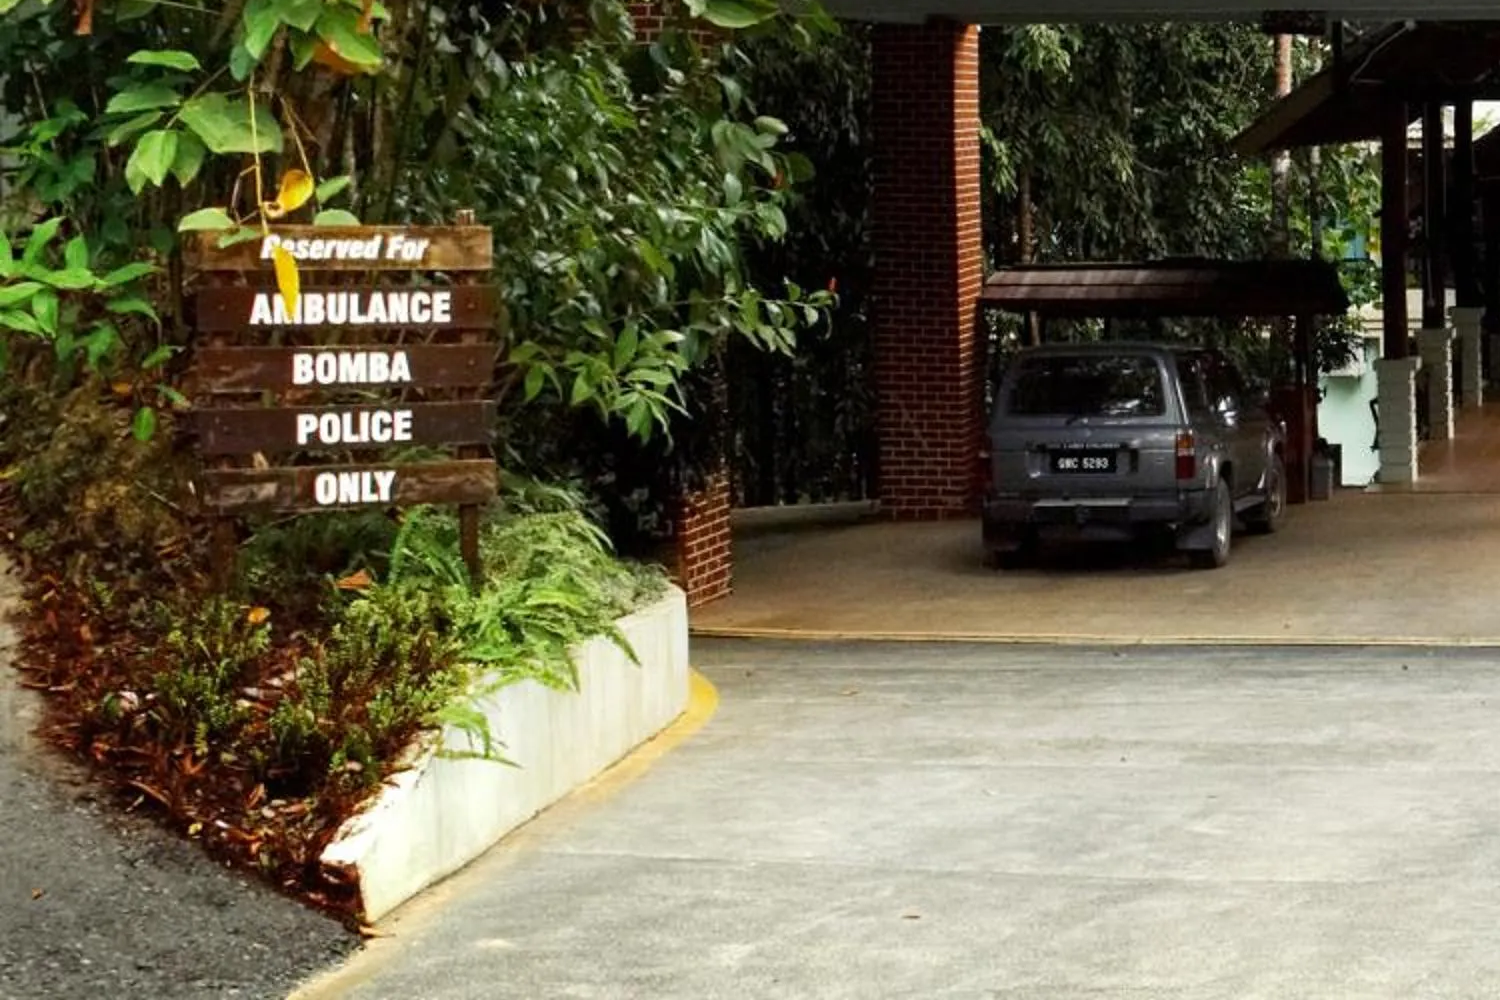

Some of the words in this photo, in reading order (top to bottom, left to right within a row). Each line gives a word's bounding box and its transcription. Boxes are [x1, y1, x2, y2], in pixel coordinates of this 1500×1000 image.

[385, 235, 430, 259] For
[292, 351, 412, 385] BOMBA
[296, 410, 413, 444] POLICE
[314, 471, 396, 504] ONLY
